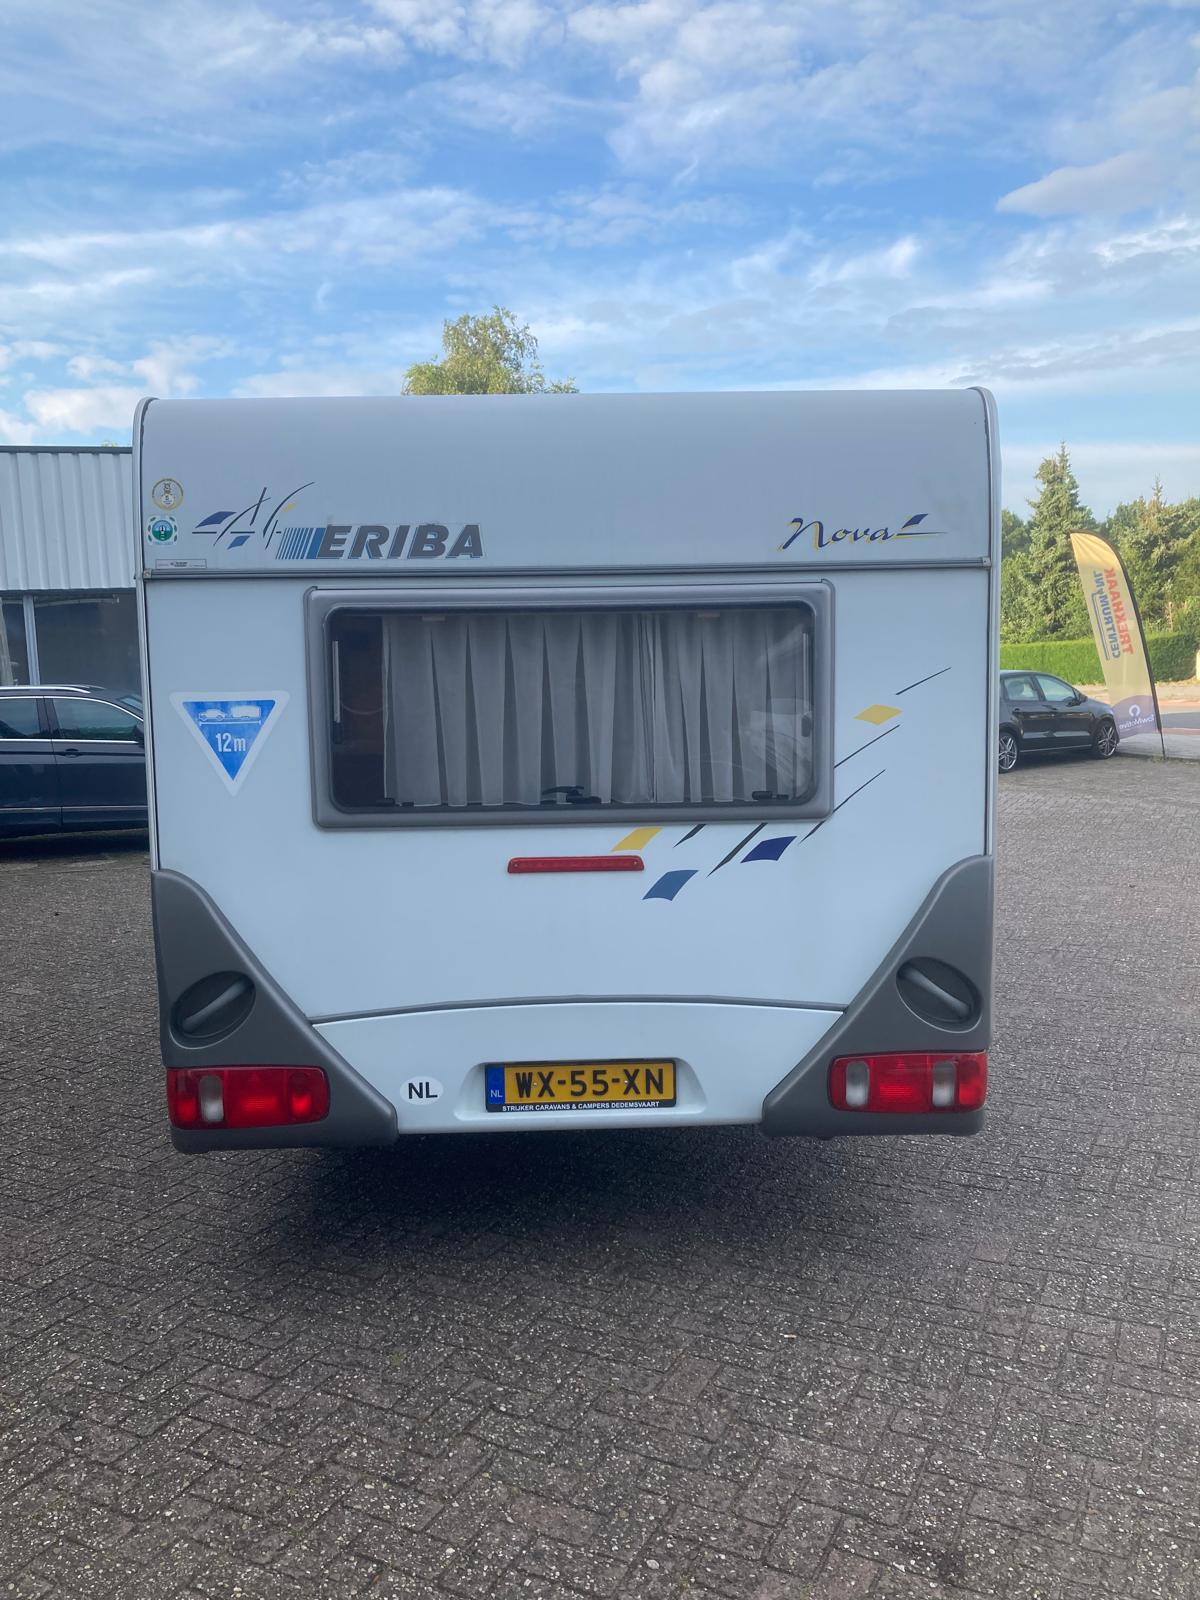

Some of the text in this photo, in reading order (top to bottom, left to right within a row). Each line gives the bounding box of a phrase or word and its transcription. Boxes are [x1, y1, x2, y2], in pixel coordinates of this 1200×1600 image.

[316, 524, 485, 560] ERIBA
[777, 517, 896, 551] Nova
[408, 1081, 438, 1100] NL
[490, 1089, 503, 1098] NL
[515, 1067, 665, 1099] WX-55-XN
[502, 1104, 534, 1112] STRIJKER
[535, 1103, 571, 1111] CARAVANS
[611, 1101, 660, 1109] DEDEMSVAART
